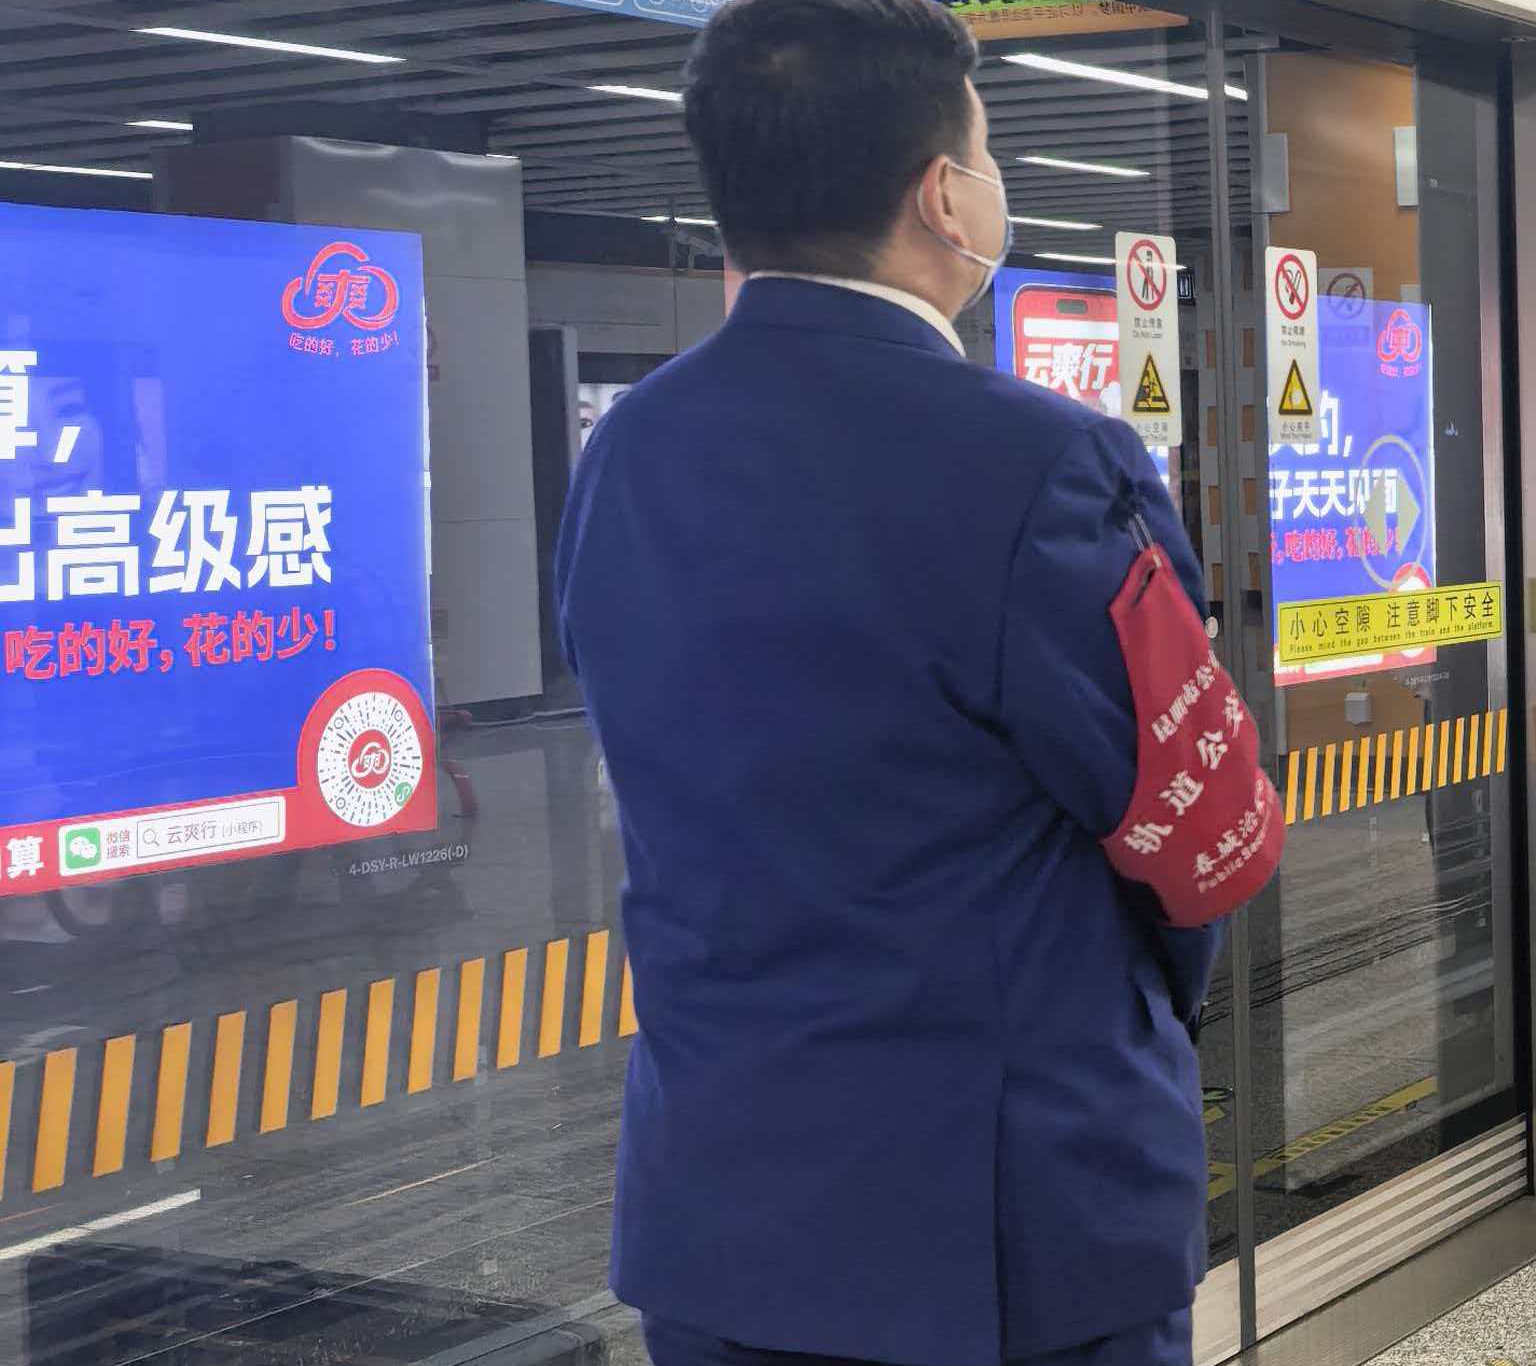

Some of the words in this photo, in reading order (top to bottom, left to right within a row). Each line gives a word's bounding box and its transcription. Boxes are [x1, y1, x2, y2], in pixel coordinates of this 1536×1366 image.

[1290, 604, 1371, 641] 小心空隙
[1386, 591, 1494, 629] 注意脚下安全
[1289, 644, 1313, 653] Please
[1318, 641, 1335, 650] mind
[1356, 637, 1368, 648] gap
[1373, 634, 1400, 644] between
[1419, 628, 1436, 637] train
[1439, 626, 1450, 634] and
[106, 830, 130, 844] 微信
[167, 820, 217, 845] 云爽行
